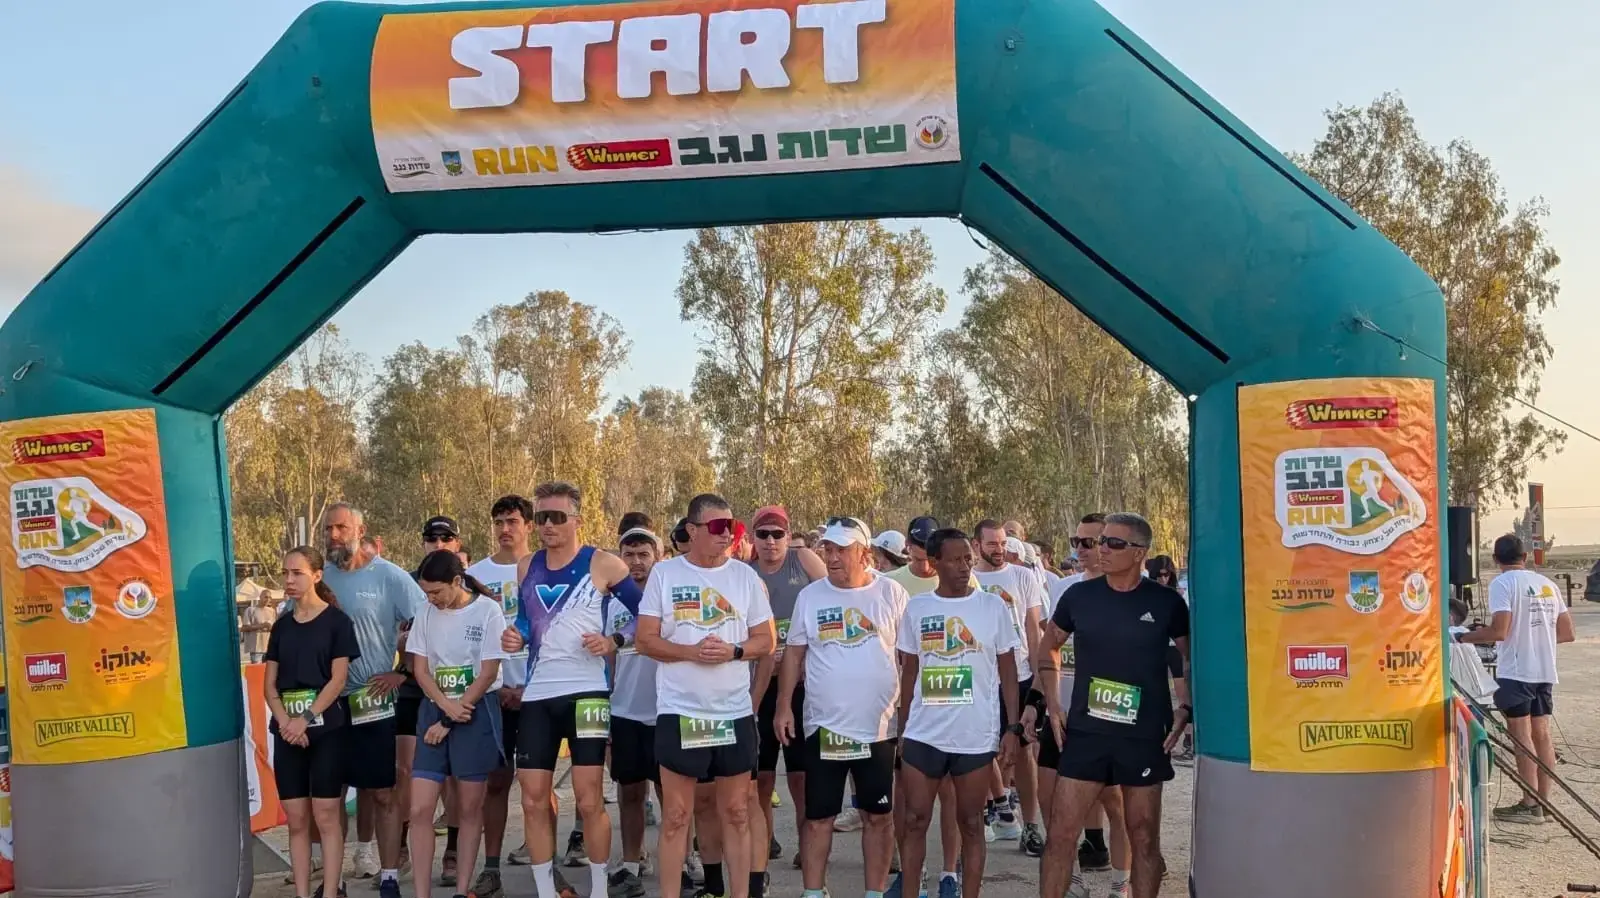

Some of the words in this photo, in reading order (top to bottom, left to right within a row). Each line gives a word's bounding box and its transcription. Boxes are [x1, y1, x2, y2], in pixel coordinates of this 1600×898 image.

[448, 0, 886, 109] START
[680, 134, 768, 166] נגב
[777, 124, 907, 160] שדות
[472, 145, 559, 176] RUN
[586, 145, 660, 165] Winner
[1307, 403, 1389, 423] Winner
[23, 440, 93, 457] Winner
[1284, 456, 1342, 471] שדות
[1285, 470, 1344, 490] נגב
[14, 486, 53, 501] שדות
[16, 499, 56, 519] נגב
[1287, 506, 1345, 526] RUN
[18, 531, 58, 549] RUN
[1271, 588, 1293, 600] נגב
[1297, 588, 1335, 600] שדות
[27, 603, 53, 615] שדות
[28, 659, 62, 677] müller
[1294, 651, 1342, 671] müller
[438, 673, 468, 687] 1094
[927, 674, 965, 690] 1177
[1094, 687, 1134, 709] 1045
[38, 719, 82, 744] NATURE
[82, 715, 130, 736] VALLEY
[688, 718, 727, 732] 1112
[1305, 724, 1363, 747] NATURE
[1363, 722, 1409, 745] VALLEY
[826, 731, 861, 746] 104
